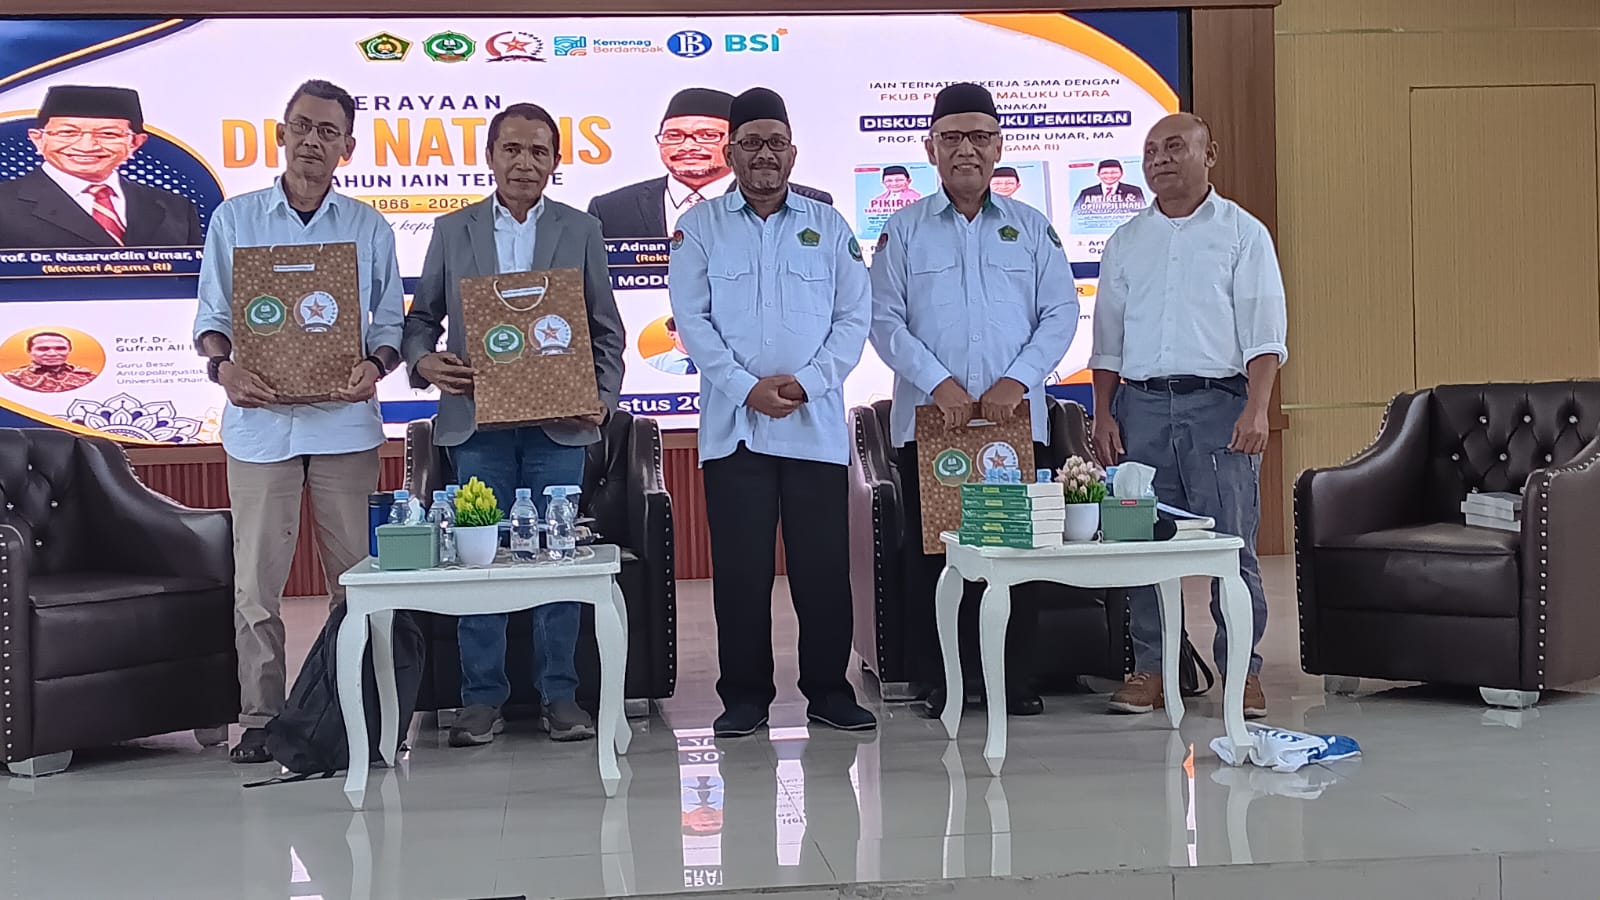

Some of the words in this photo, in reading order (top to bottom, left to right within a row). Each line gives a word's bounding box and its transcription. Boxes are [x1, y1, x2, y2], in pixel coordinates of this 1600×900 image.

[593, 39, 651, 47] Kemenag
[725, 33, 780, 52] BSI
[593, 46, 663, 54] Berdampak
[1024, 79, 1060, 87] SAMA
[1064, 78, 1120, 86] DENGAN
[880, 93, 918, 101] FKUB
[996, 91, 1058, 99] MALUKU
[353, 95, 501, 111] ERAYAAN
[863, 117, 932, 128] DISKUSI
[1033, 113, 1128, 125] PEMIKIRAN
[374, 115, 612, 167] NATIS
[1044, 132, 1089, 140] UMAR,
[332, 174, 391, 187] AHUN
[401, 174, 448, 187] IAIN
[372, 199, 409, 209] 1966
[871, 199, 917, 208] PIKIRA
[620, 242, 667, 252] Adnan
[0, 252, 28, 262] rof.
[30, 252, 53, 262] Dr.
[55, 251, 145, 262] Nasaruddin
[147, 250, 193, 261] Umar,
[41, 263, 101, 274] (Menteri
[103, 264, 151, 274] Agama
[152, 262, 172, 272] RI)
[116, 336, 148, 344] Prof.
[116, 344, 163, 352] Gufran
